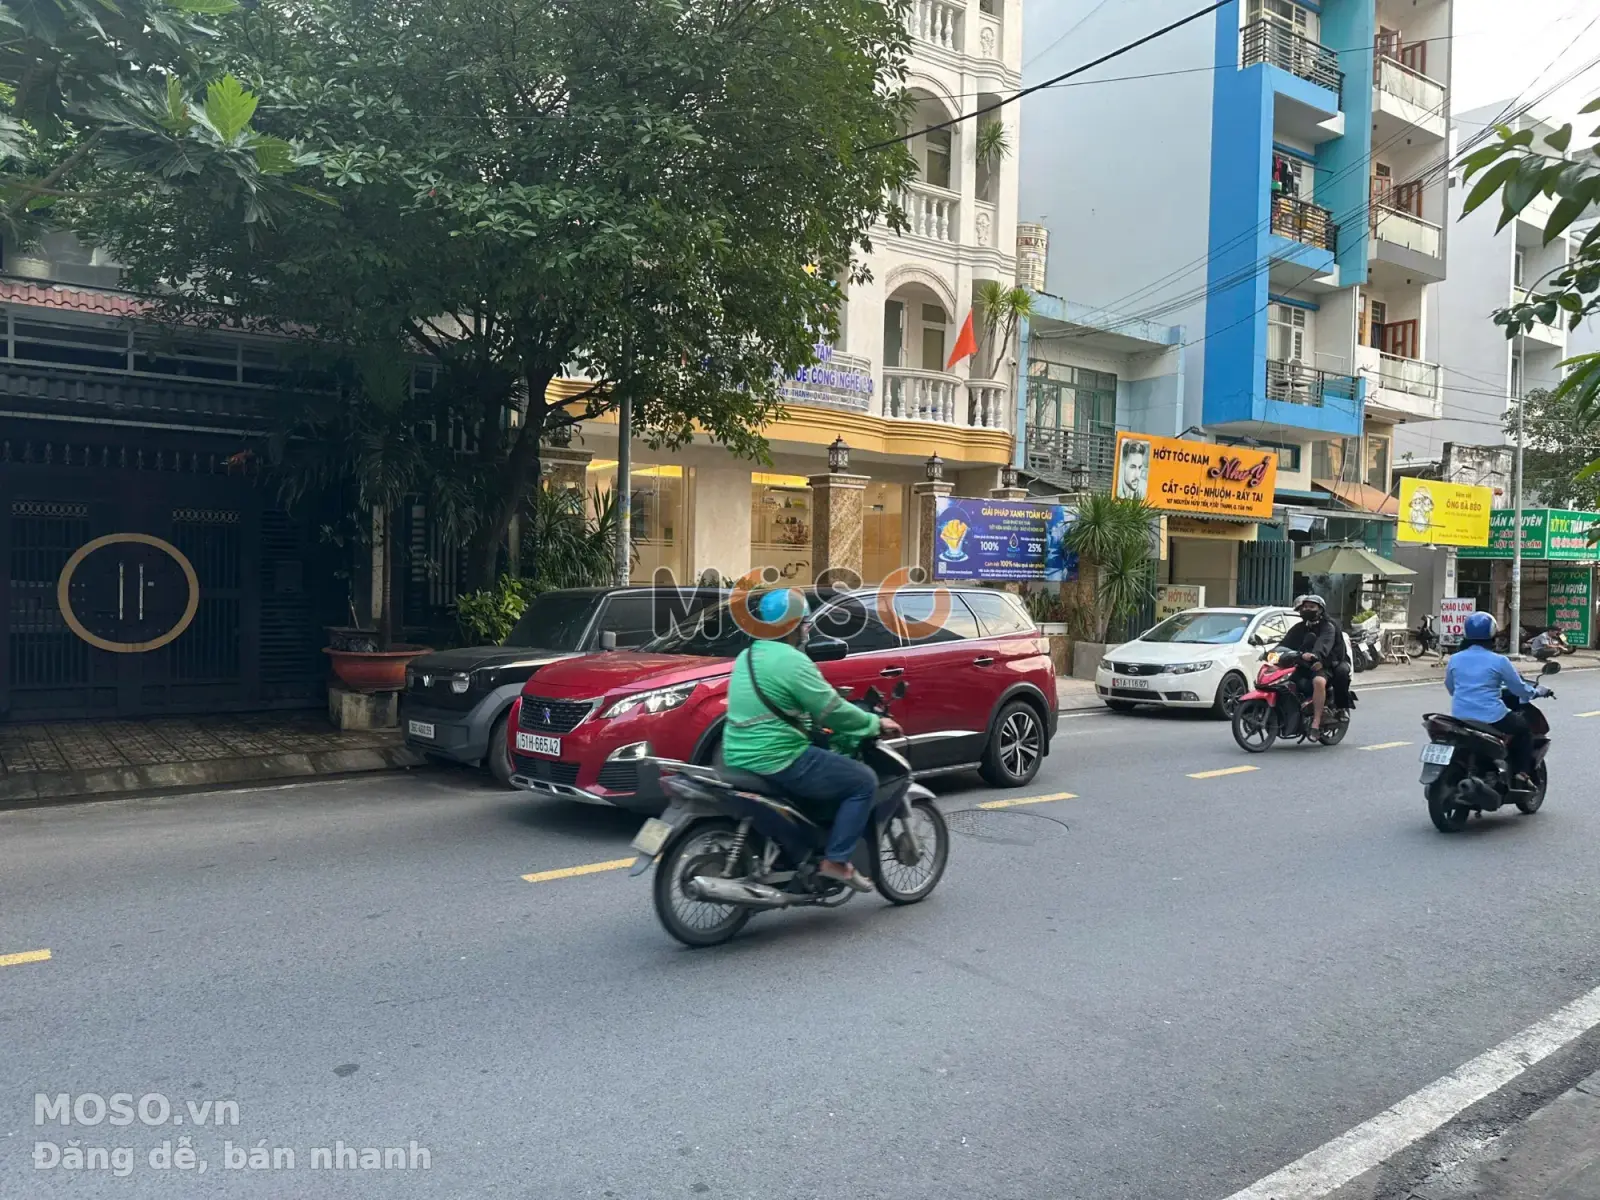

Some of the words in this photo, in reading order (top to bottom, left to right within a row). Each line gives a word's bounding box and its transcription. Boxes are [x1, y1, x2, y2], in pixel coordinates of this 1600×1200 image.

[811, 364, 836, 386] CÔNG
[1153, 446, 1172, 461] HỚT
[1173, 448, 1191, 463] TÓC
[1191, 455, 1210, 465] NAM
[1183, 483, 1199, 499] GỘI
[1252, 492, 1264, 503] TAI
[982, 506, 994, 516] GIẢI
[994, 507, 1009, 517] PHÁP
[1009, 509, 1025, 518] XANH
[1490, 513, 1508, 527] UẤN
[1508, 513, 1543, 527] NUYÊN
[980, 541, 999, 551] 100%
[1027, 543, 1042, 552] 25%
[1167, 588, 1182, 602] HỚT
[520, 734, 559, 754] 51H-665.42
